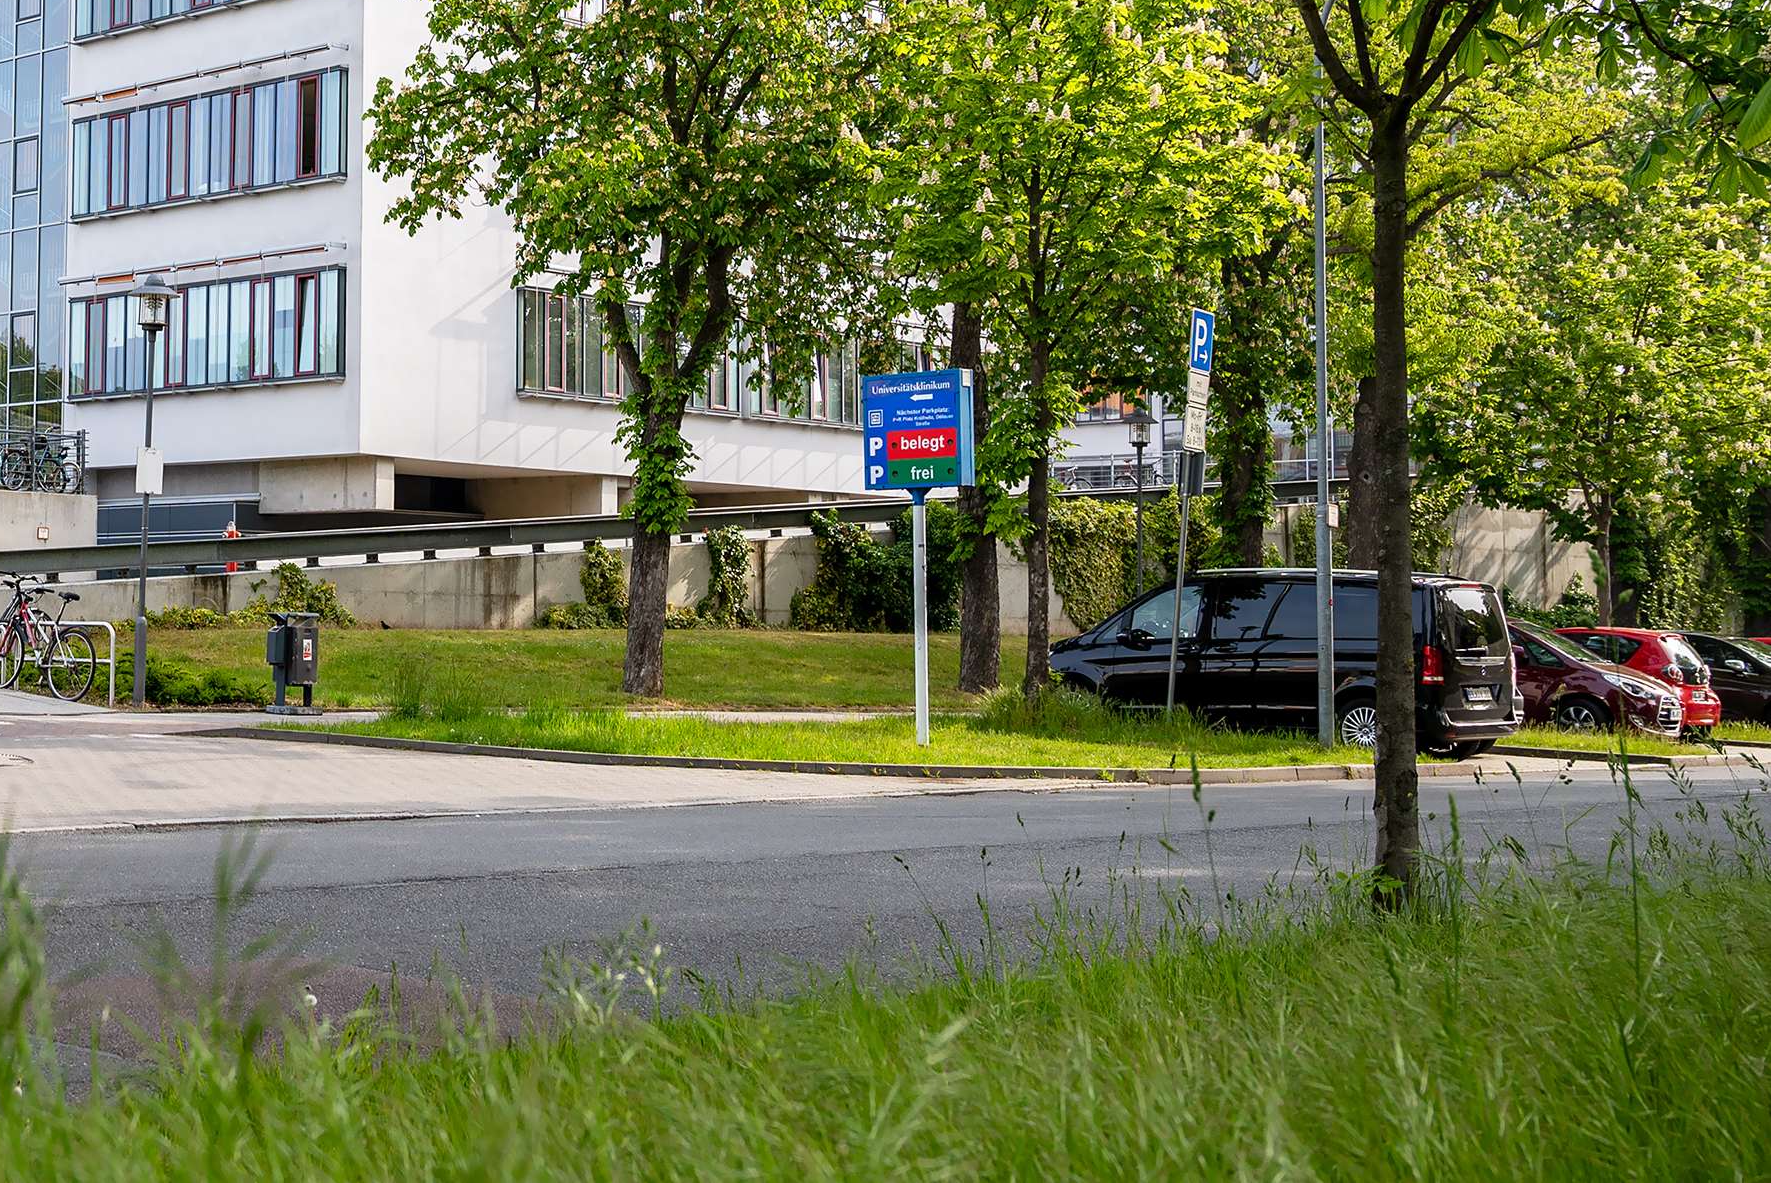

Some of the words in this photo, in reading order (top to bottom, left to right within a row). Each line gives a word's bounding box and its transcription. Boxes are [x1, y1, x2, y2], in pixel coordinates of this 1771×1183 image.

[1194, 318, 1207, 362] P
[872, 381, 950, 394] Universitätsklinikum
[870, 437, 883, 456] P
[900, 435, 944, 451] belegt
[870, 465, 884, 485] P
[911, 465, 934, 480] frei
